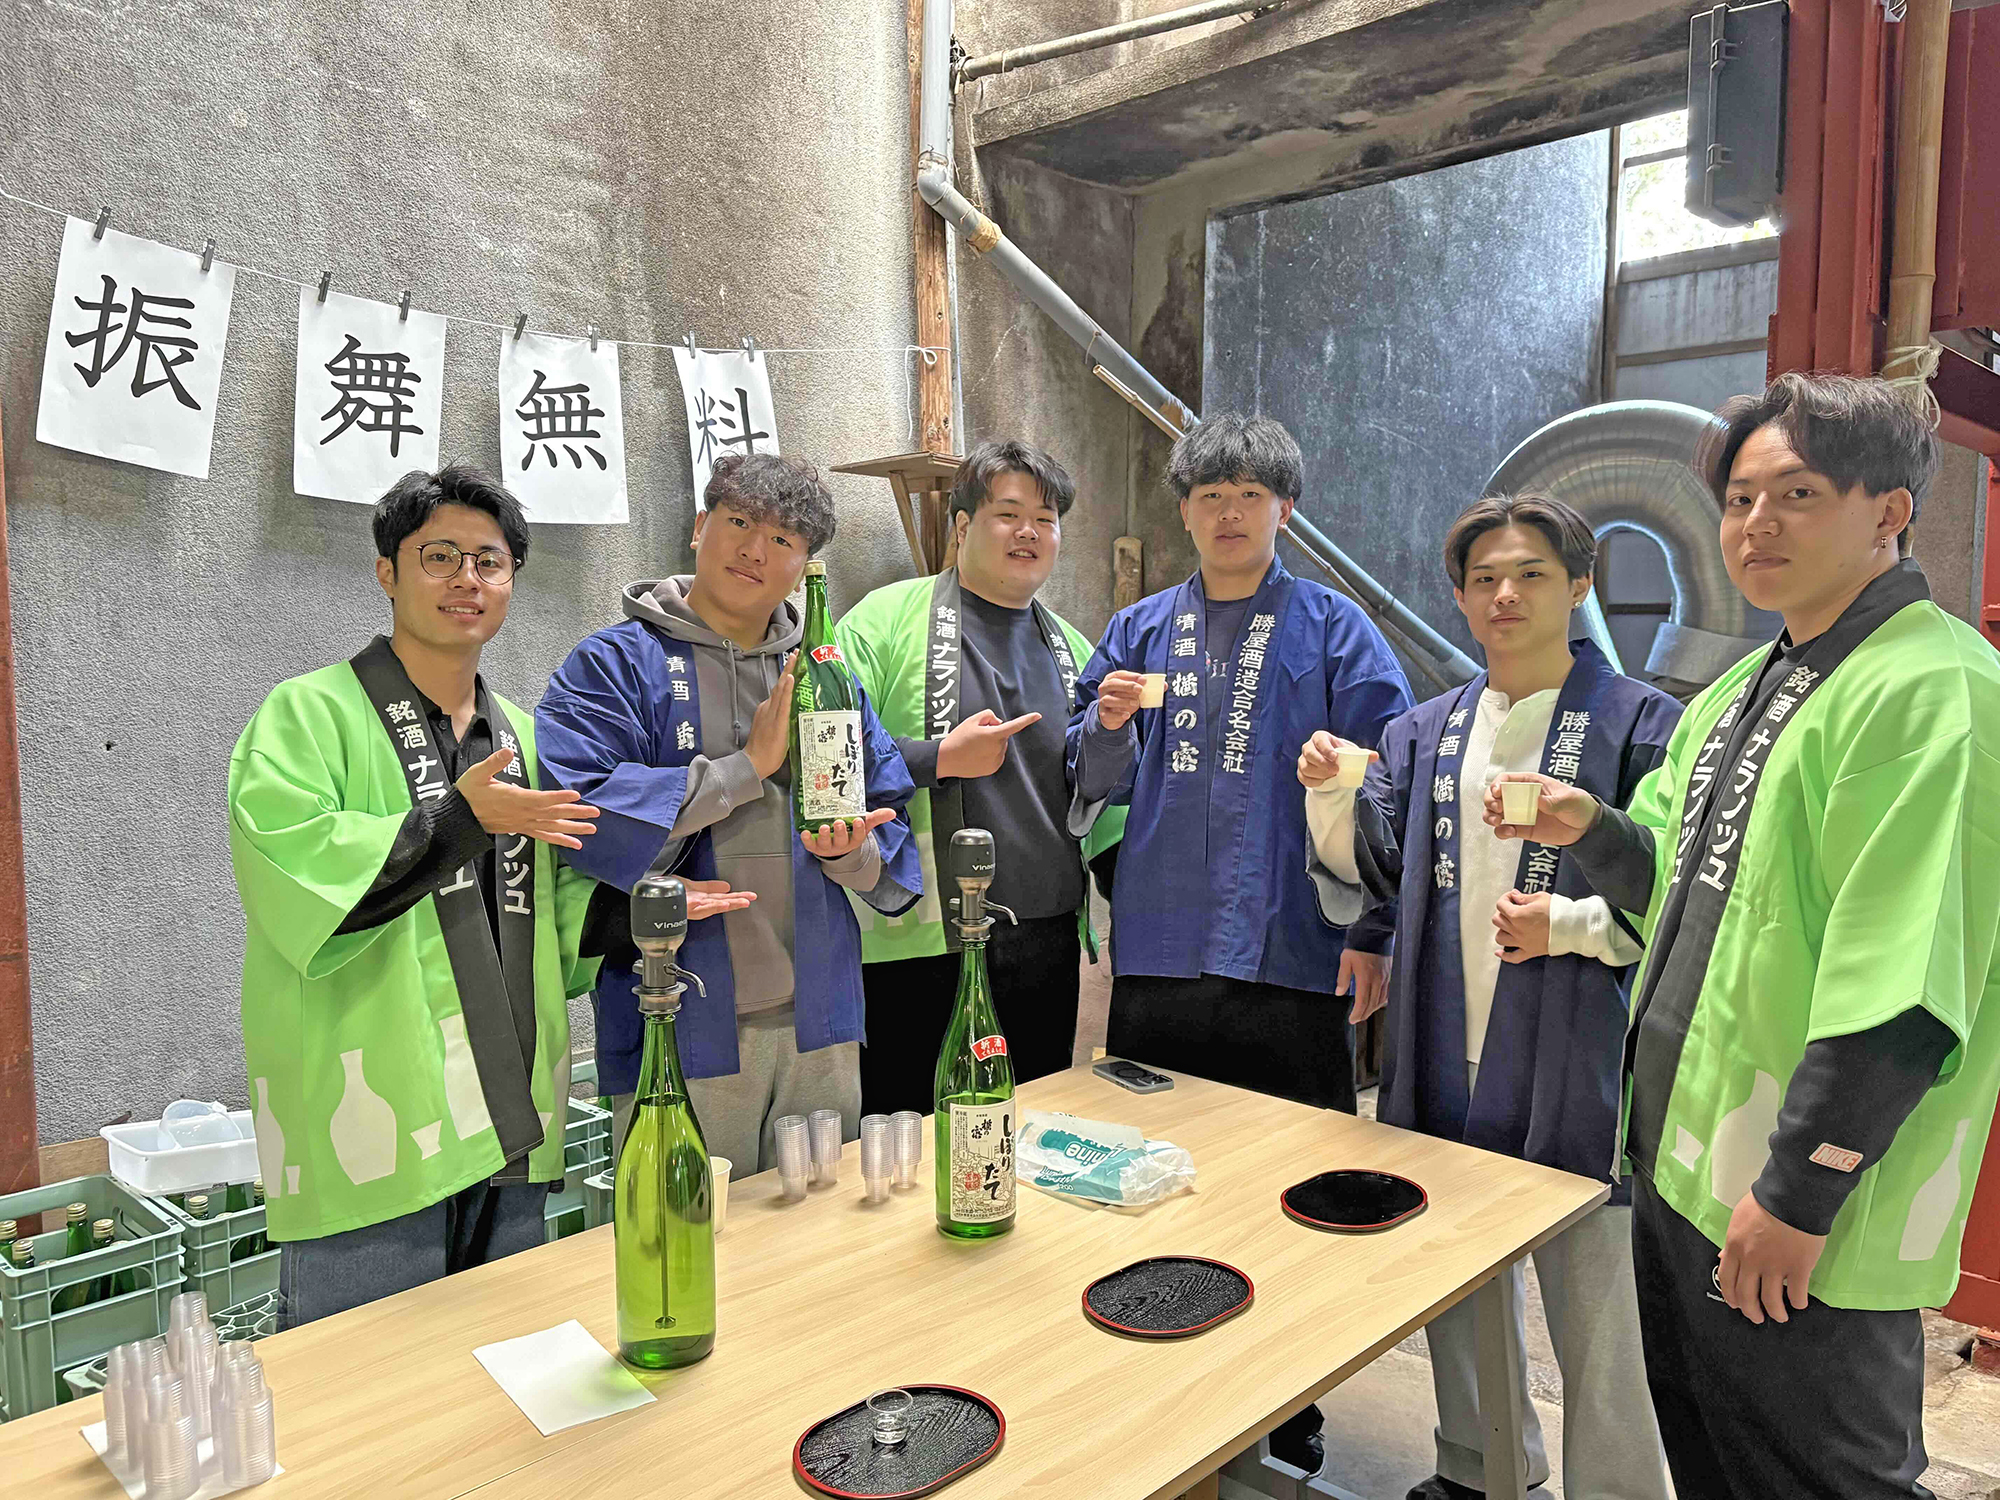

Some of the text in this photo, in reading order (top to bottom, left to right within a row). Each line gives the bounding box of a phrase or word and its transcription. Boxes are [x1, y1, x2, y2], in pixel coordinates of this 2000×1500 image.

[1222, 613, 1276, 775] 勝屋酒造合名会社
[831, 763, 847, 797] たて
[1699, 666, 1819, 891] 銘酒ナラノツユ
[1815, 1146, 1859, 1169] NIKE
[983, 1163, 1000, 1200] たて
